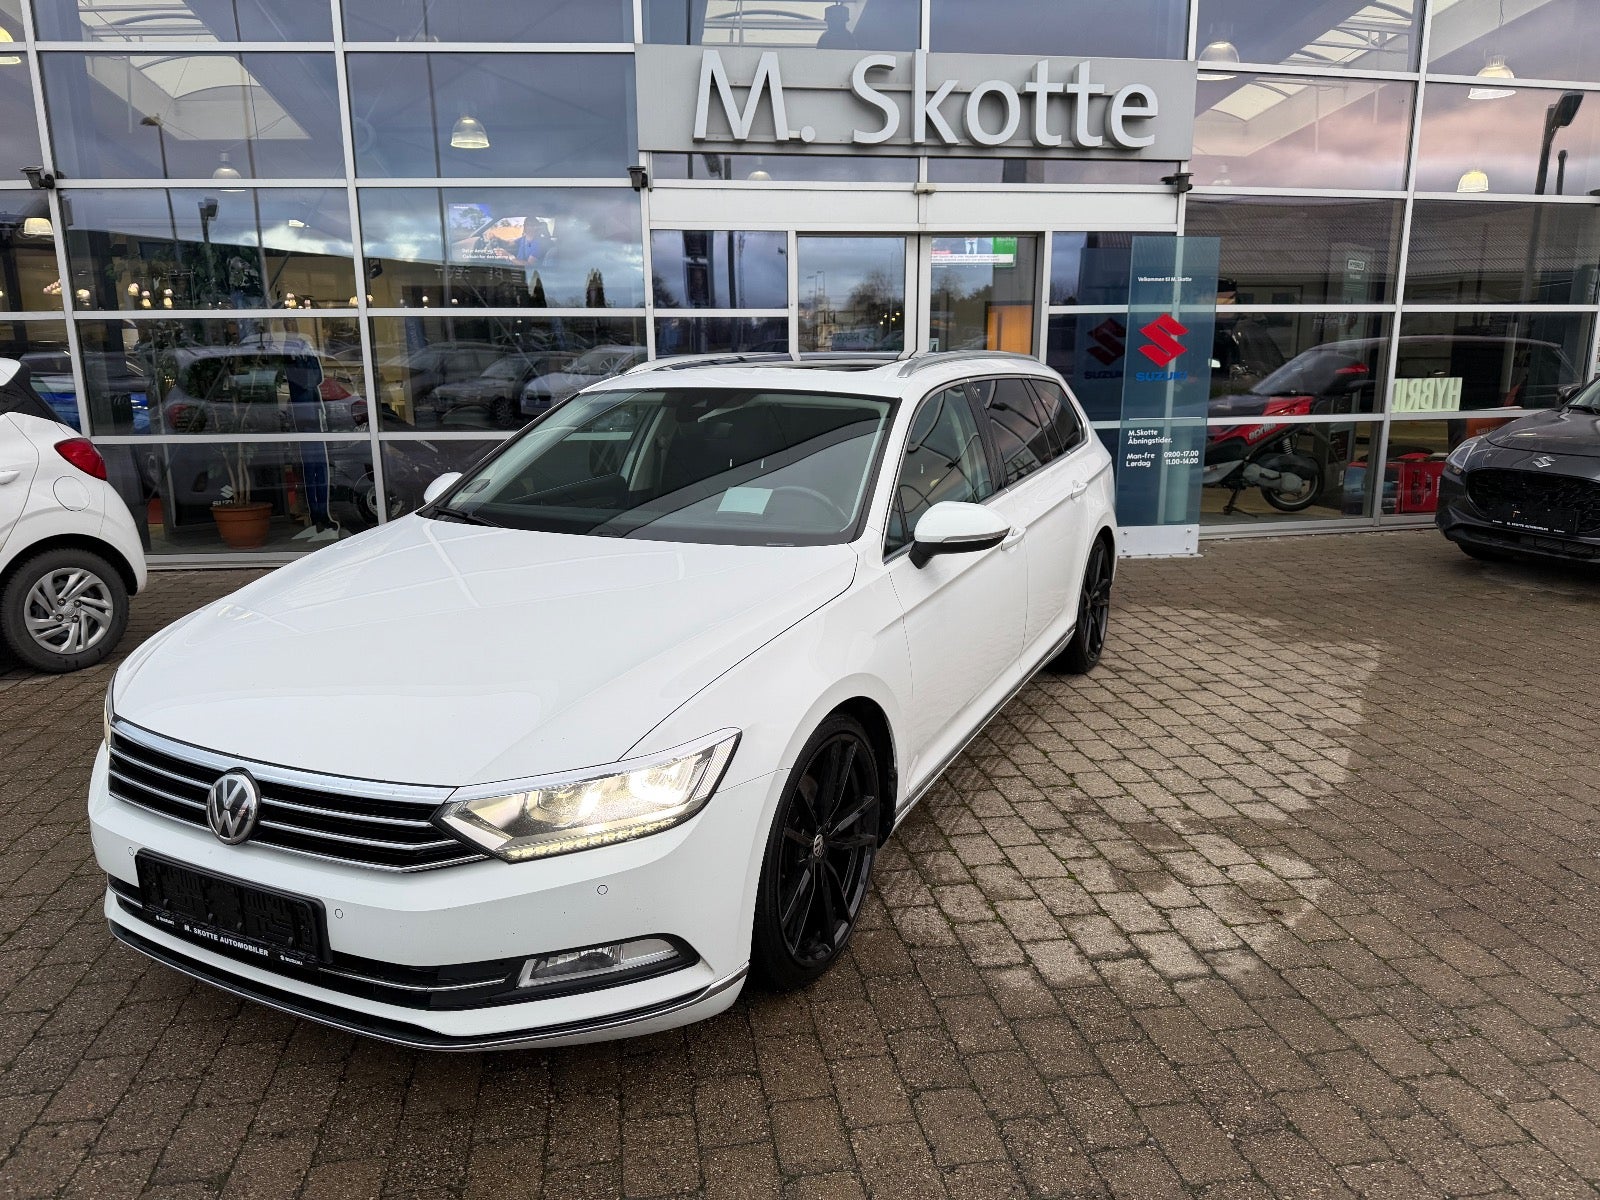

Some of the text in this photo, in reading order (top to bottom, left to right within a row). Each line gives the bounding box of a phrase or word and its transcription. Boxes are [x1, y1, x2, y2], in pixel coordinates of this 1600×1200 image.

[692, 48, 1158, 149] M. Skotte
[1136, 371, 1187, 381] SUZUKI
[1128, 437, 1172, 446] Åbningstider.
[1126, 452, 1155, 460] Man-fre
[1126, 460, 1151, 468] Lørdag
[193, 927, 218, 941] SKOTTE
[219, 936, 269, 957] AUTOMOBILER
